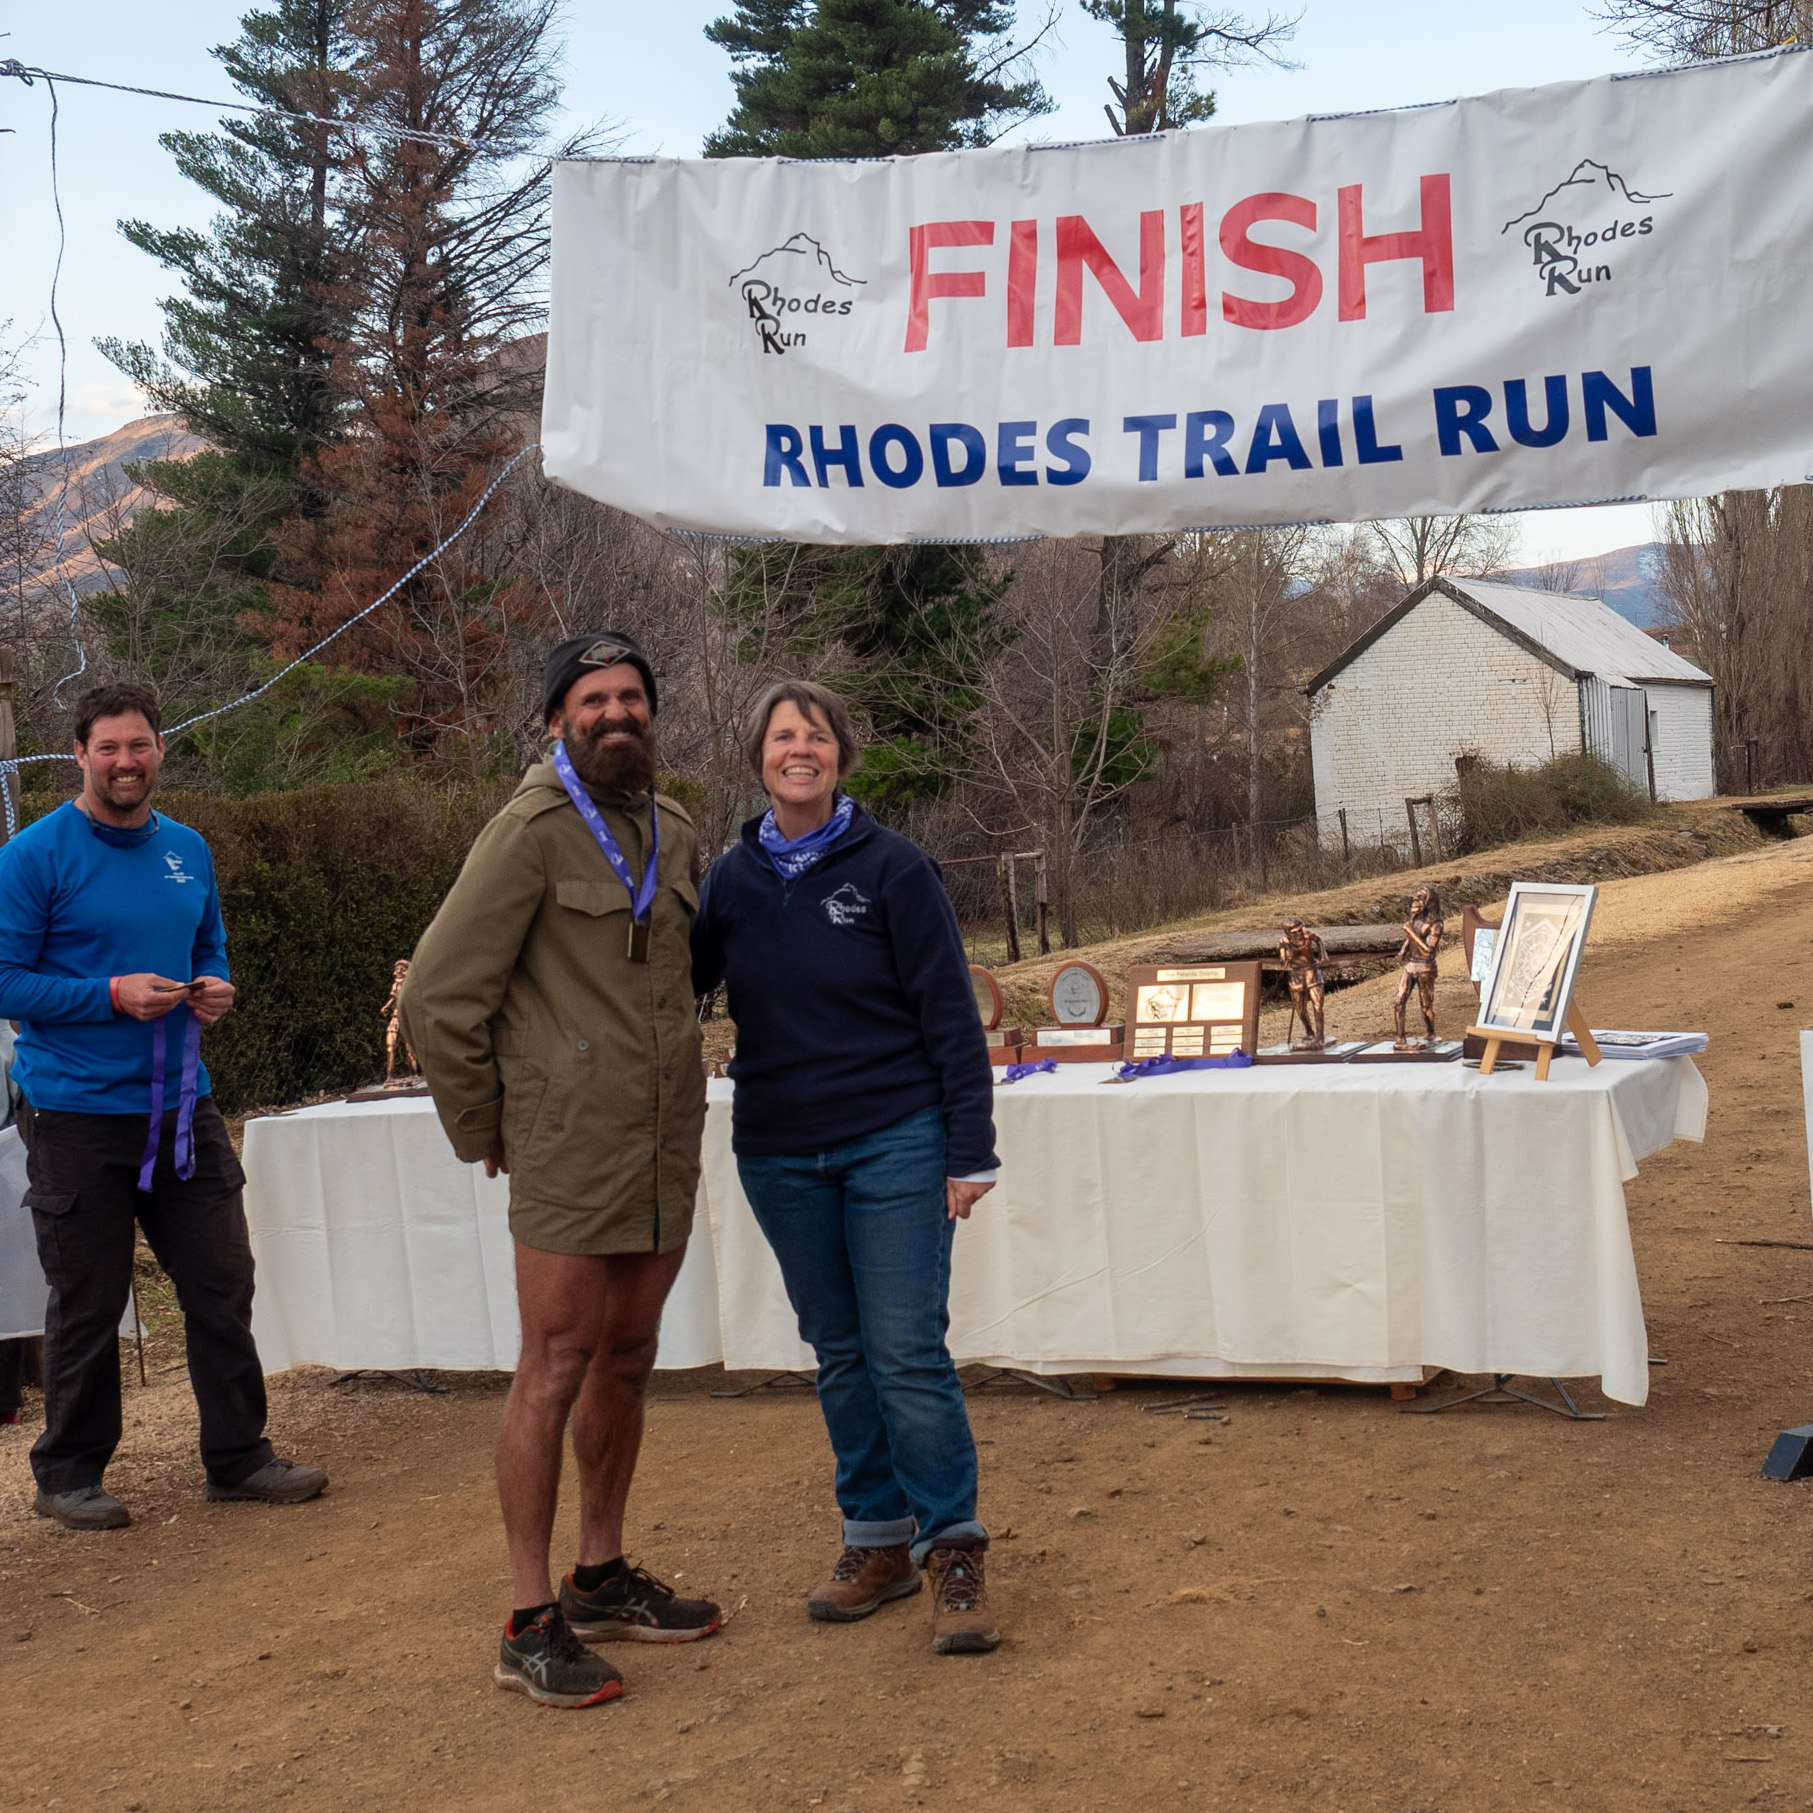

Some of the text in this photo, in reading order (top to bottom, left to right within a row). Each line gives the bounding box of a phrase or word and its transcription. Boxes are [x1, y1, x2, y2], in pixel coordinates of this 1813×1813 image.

[904, 173, 1455, 353] FINISH
[1524, 216, 1653, 265] Rhodes
[1539, 255, 1612, 296] Run
[742, 279, 853, 318] Rhodes
[755, 313, 807, 355] Run
[763, 366, 1657, 488] RHODES TRAIL RUN
